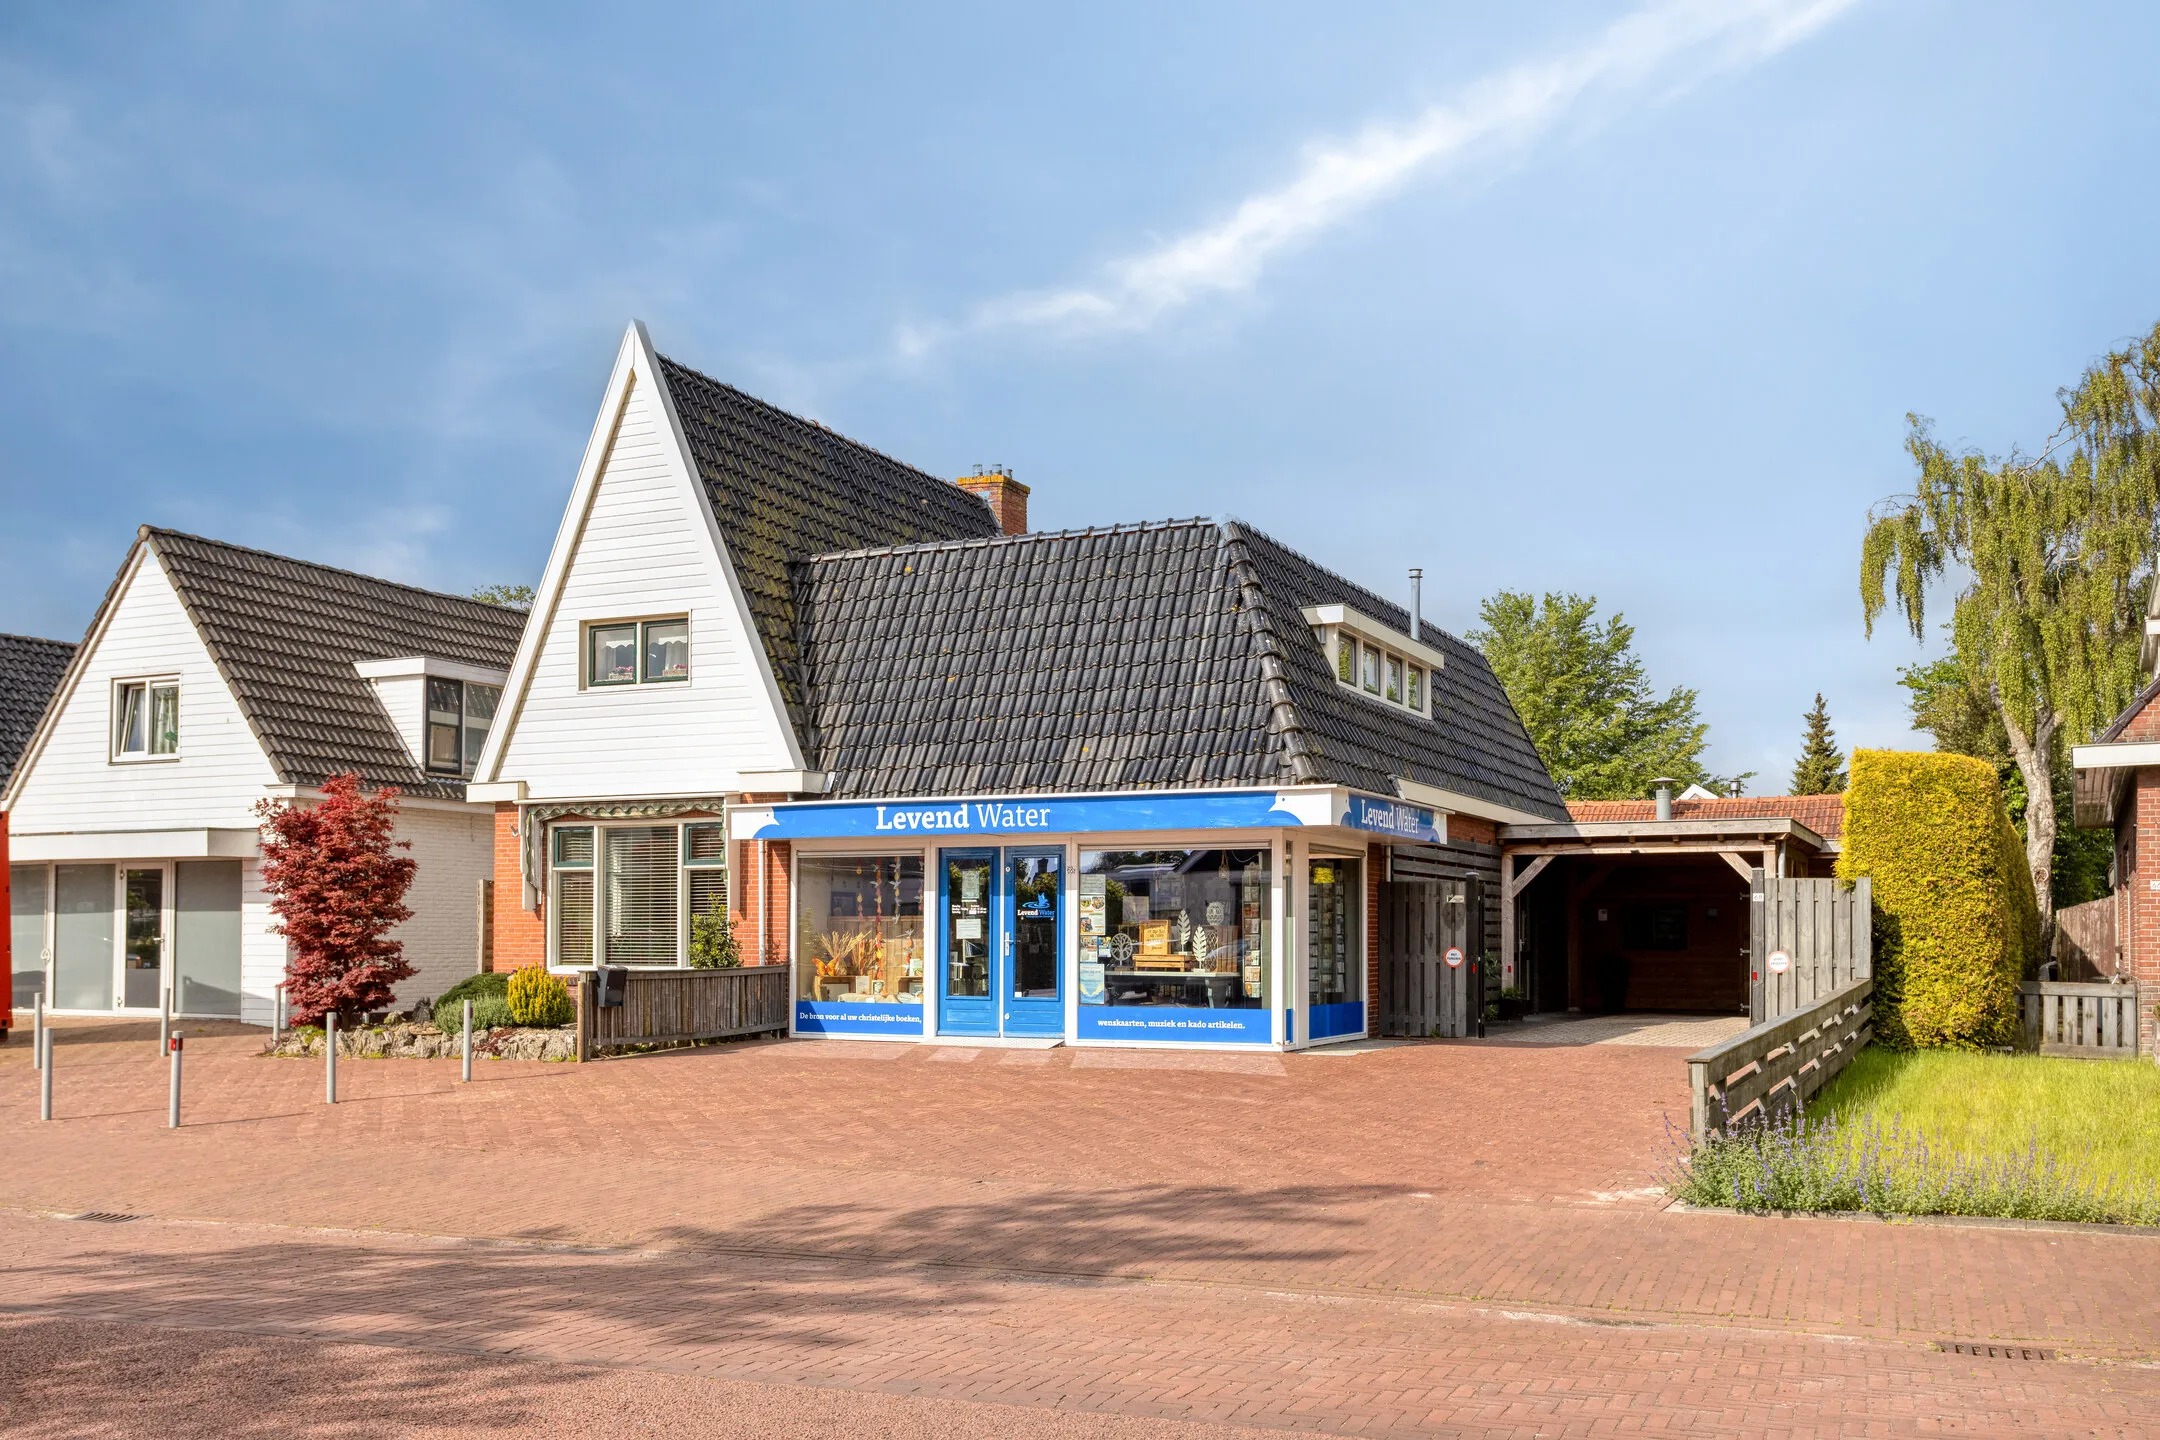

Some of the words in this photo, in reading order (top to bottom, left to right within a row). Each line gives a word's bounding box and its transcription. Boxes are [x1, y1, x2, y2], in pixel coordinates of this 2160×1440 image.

[876, 803, 970, 830] Levend
[975, 803, 1050, 828] Water
[1361, 799, 1394, 829] Levend
[1395, 807, 1420, 834] Water
[810, 1012, 824, 1020] bron
[840, 1013, 847, 1021] al
[858, 1013, 895, 1023] christelijke
[896, 1014, 921, 1024] boeken,
[1097, 1019, 1147, 1028] wenskaarten,
[1148, 1019, 1176, 1028] muziek
[1177, 1020, 1187, 1028] en
[1188, 1020, 1207, 1028] kado
[1207, 1020, 1246, 1029] artikelen.
